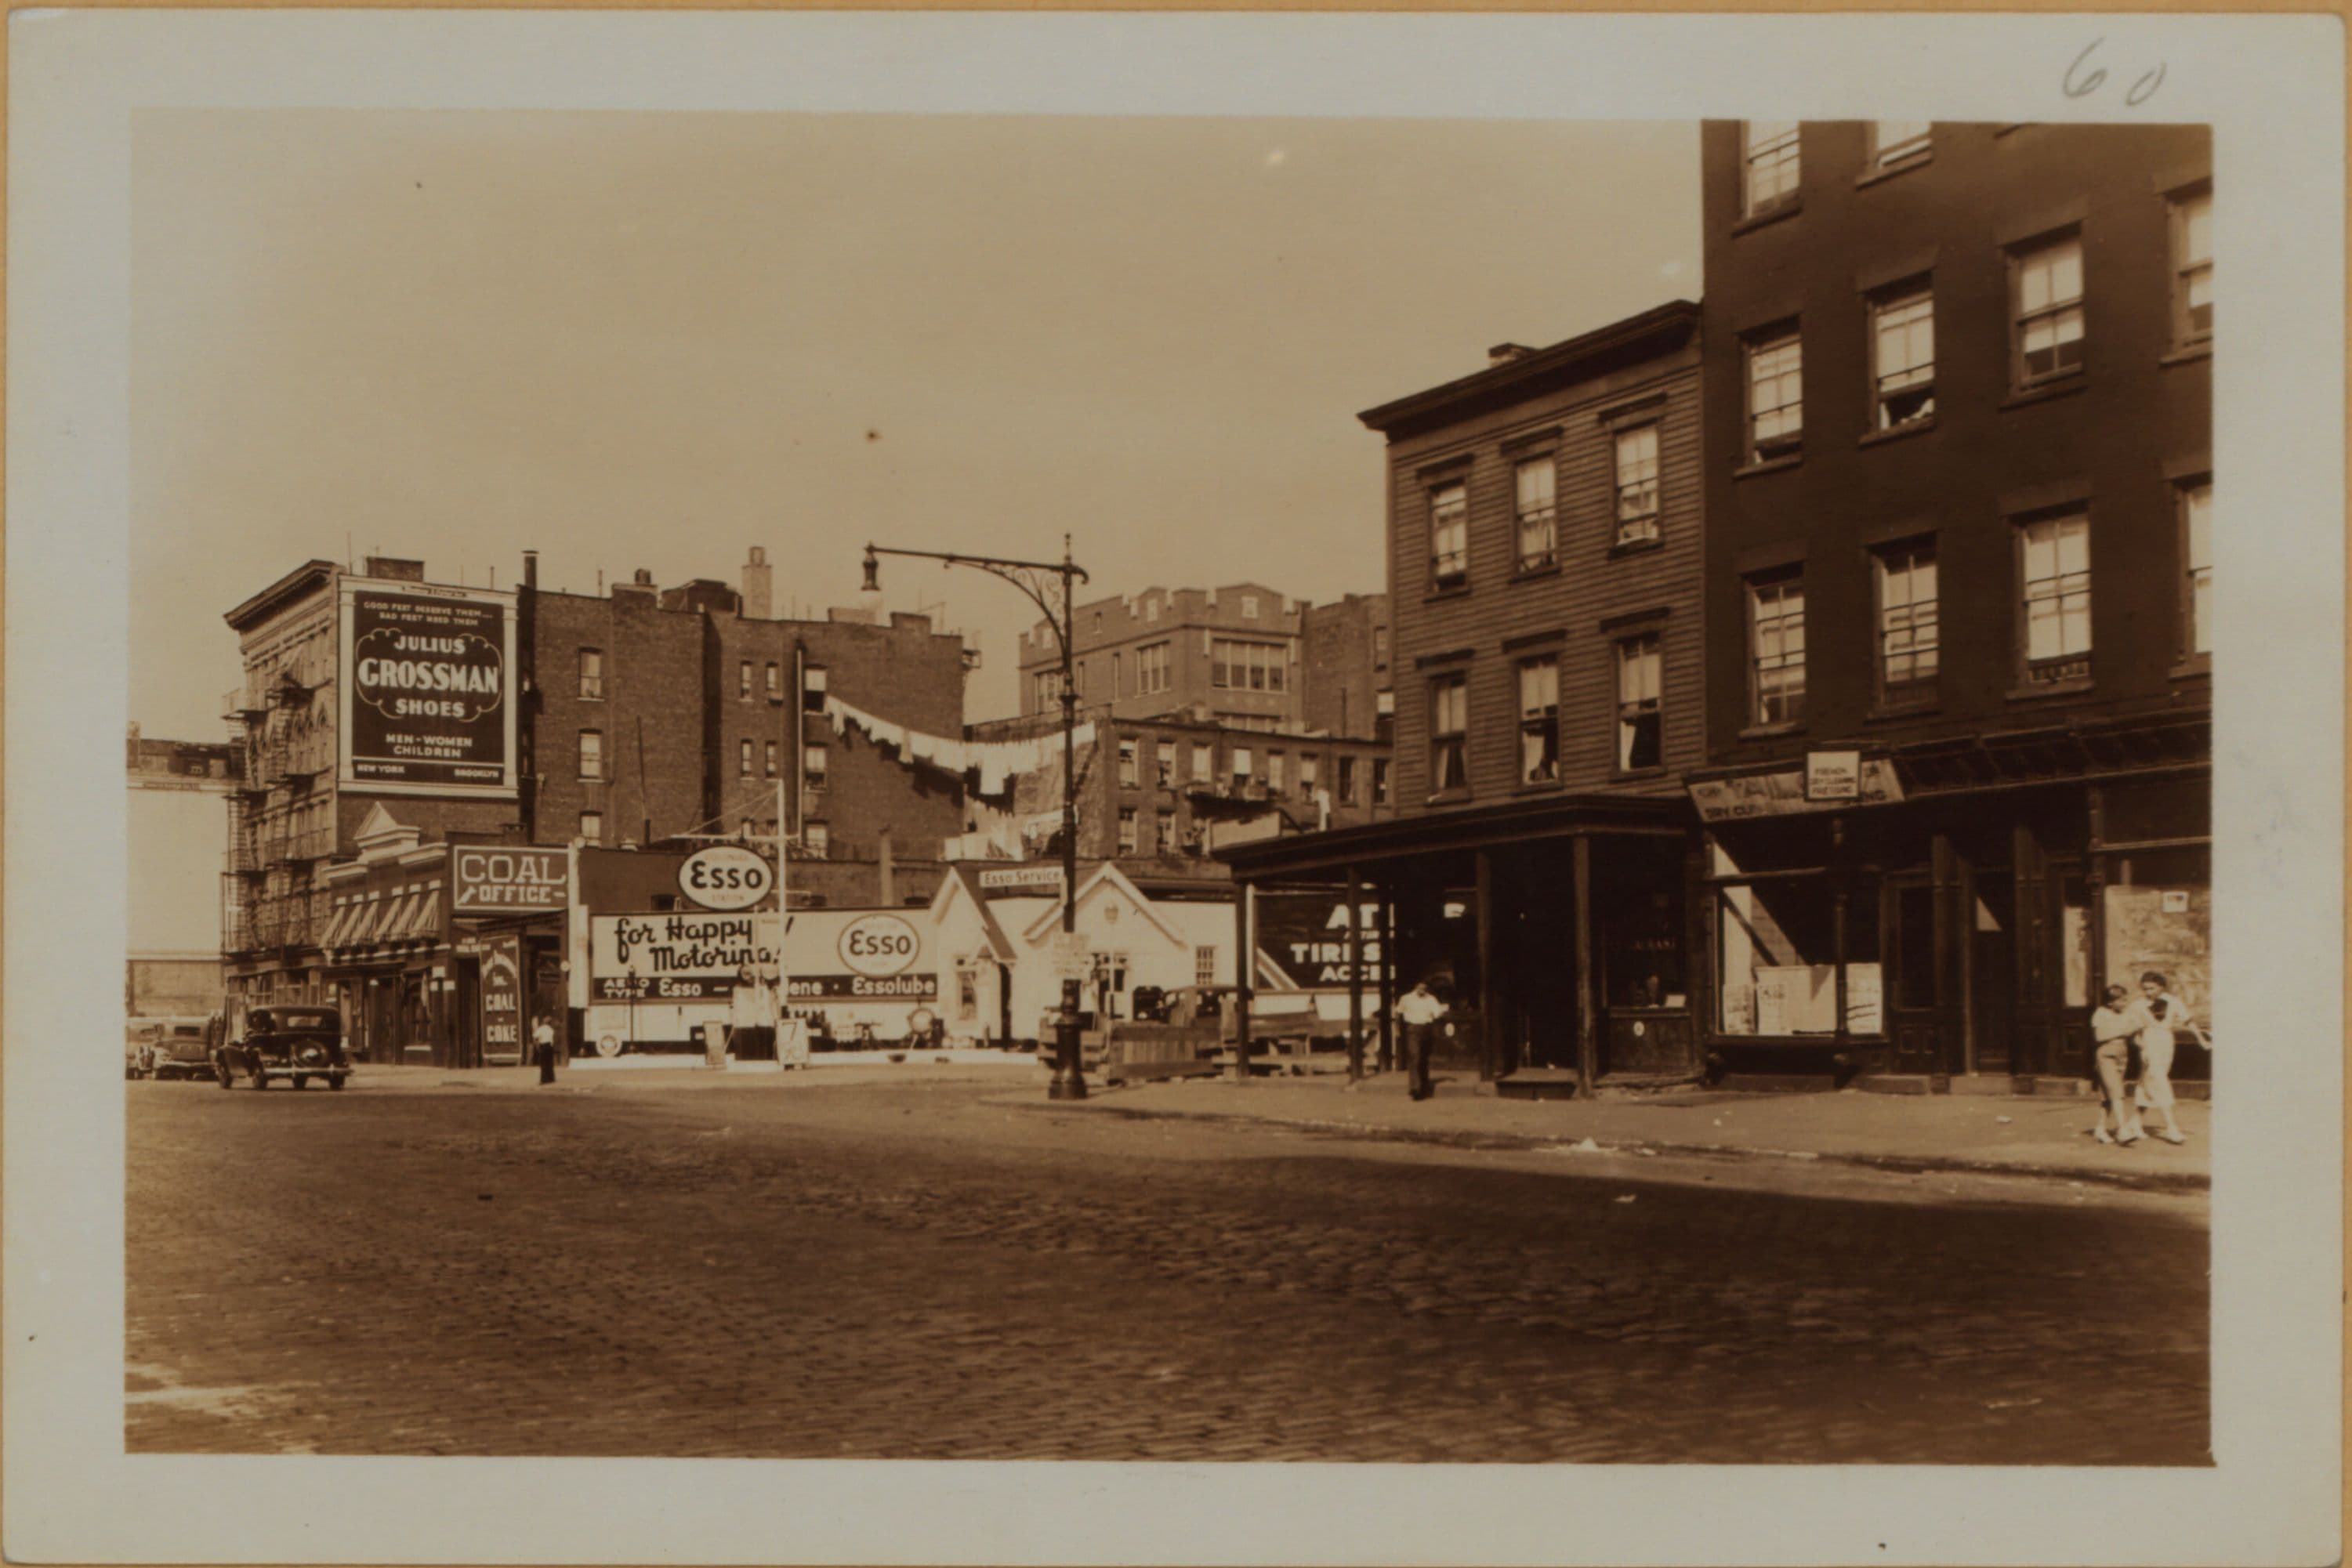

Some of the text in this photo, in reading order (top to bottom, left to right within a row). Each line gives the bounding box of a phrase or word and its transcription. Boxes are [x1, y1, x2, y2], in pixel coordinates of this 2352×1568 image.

[2062, 36, 2167, 107] 60
[394, 636, 466, 654] JULIUS
[358, 658, 498, 693] GROSSMAN
[395, 698, 465, 718] SHOES
[393, 745, 462, 758] CHILDREN
[357, 764, 405, 773] NEW YORK
[454, 769, 499, 778] BROOKLYN
[460, 854, 567, 885] COAL
[984, 870, 1060, 885] Esso Service
[479, 885, 551, 903] OFFICE
[614, 916, 752, 964] for Happy
[603, 978, 651, 988] AEO
[658, 978, 702, 998] Esso
[852, 976, 936, 995] Essolube
[486, 993, 516, 1012] COAL
[487, 1025, 517, 1043] COKE
